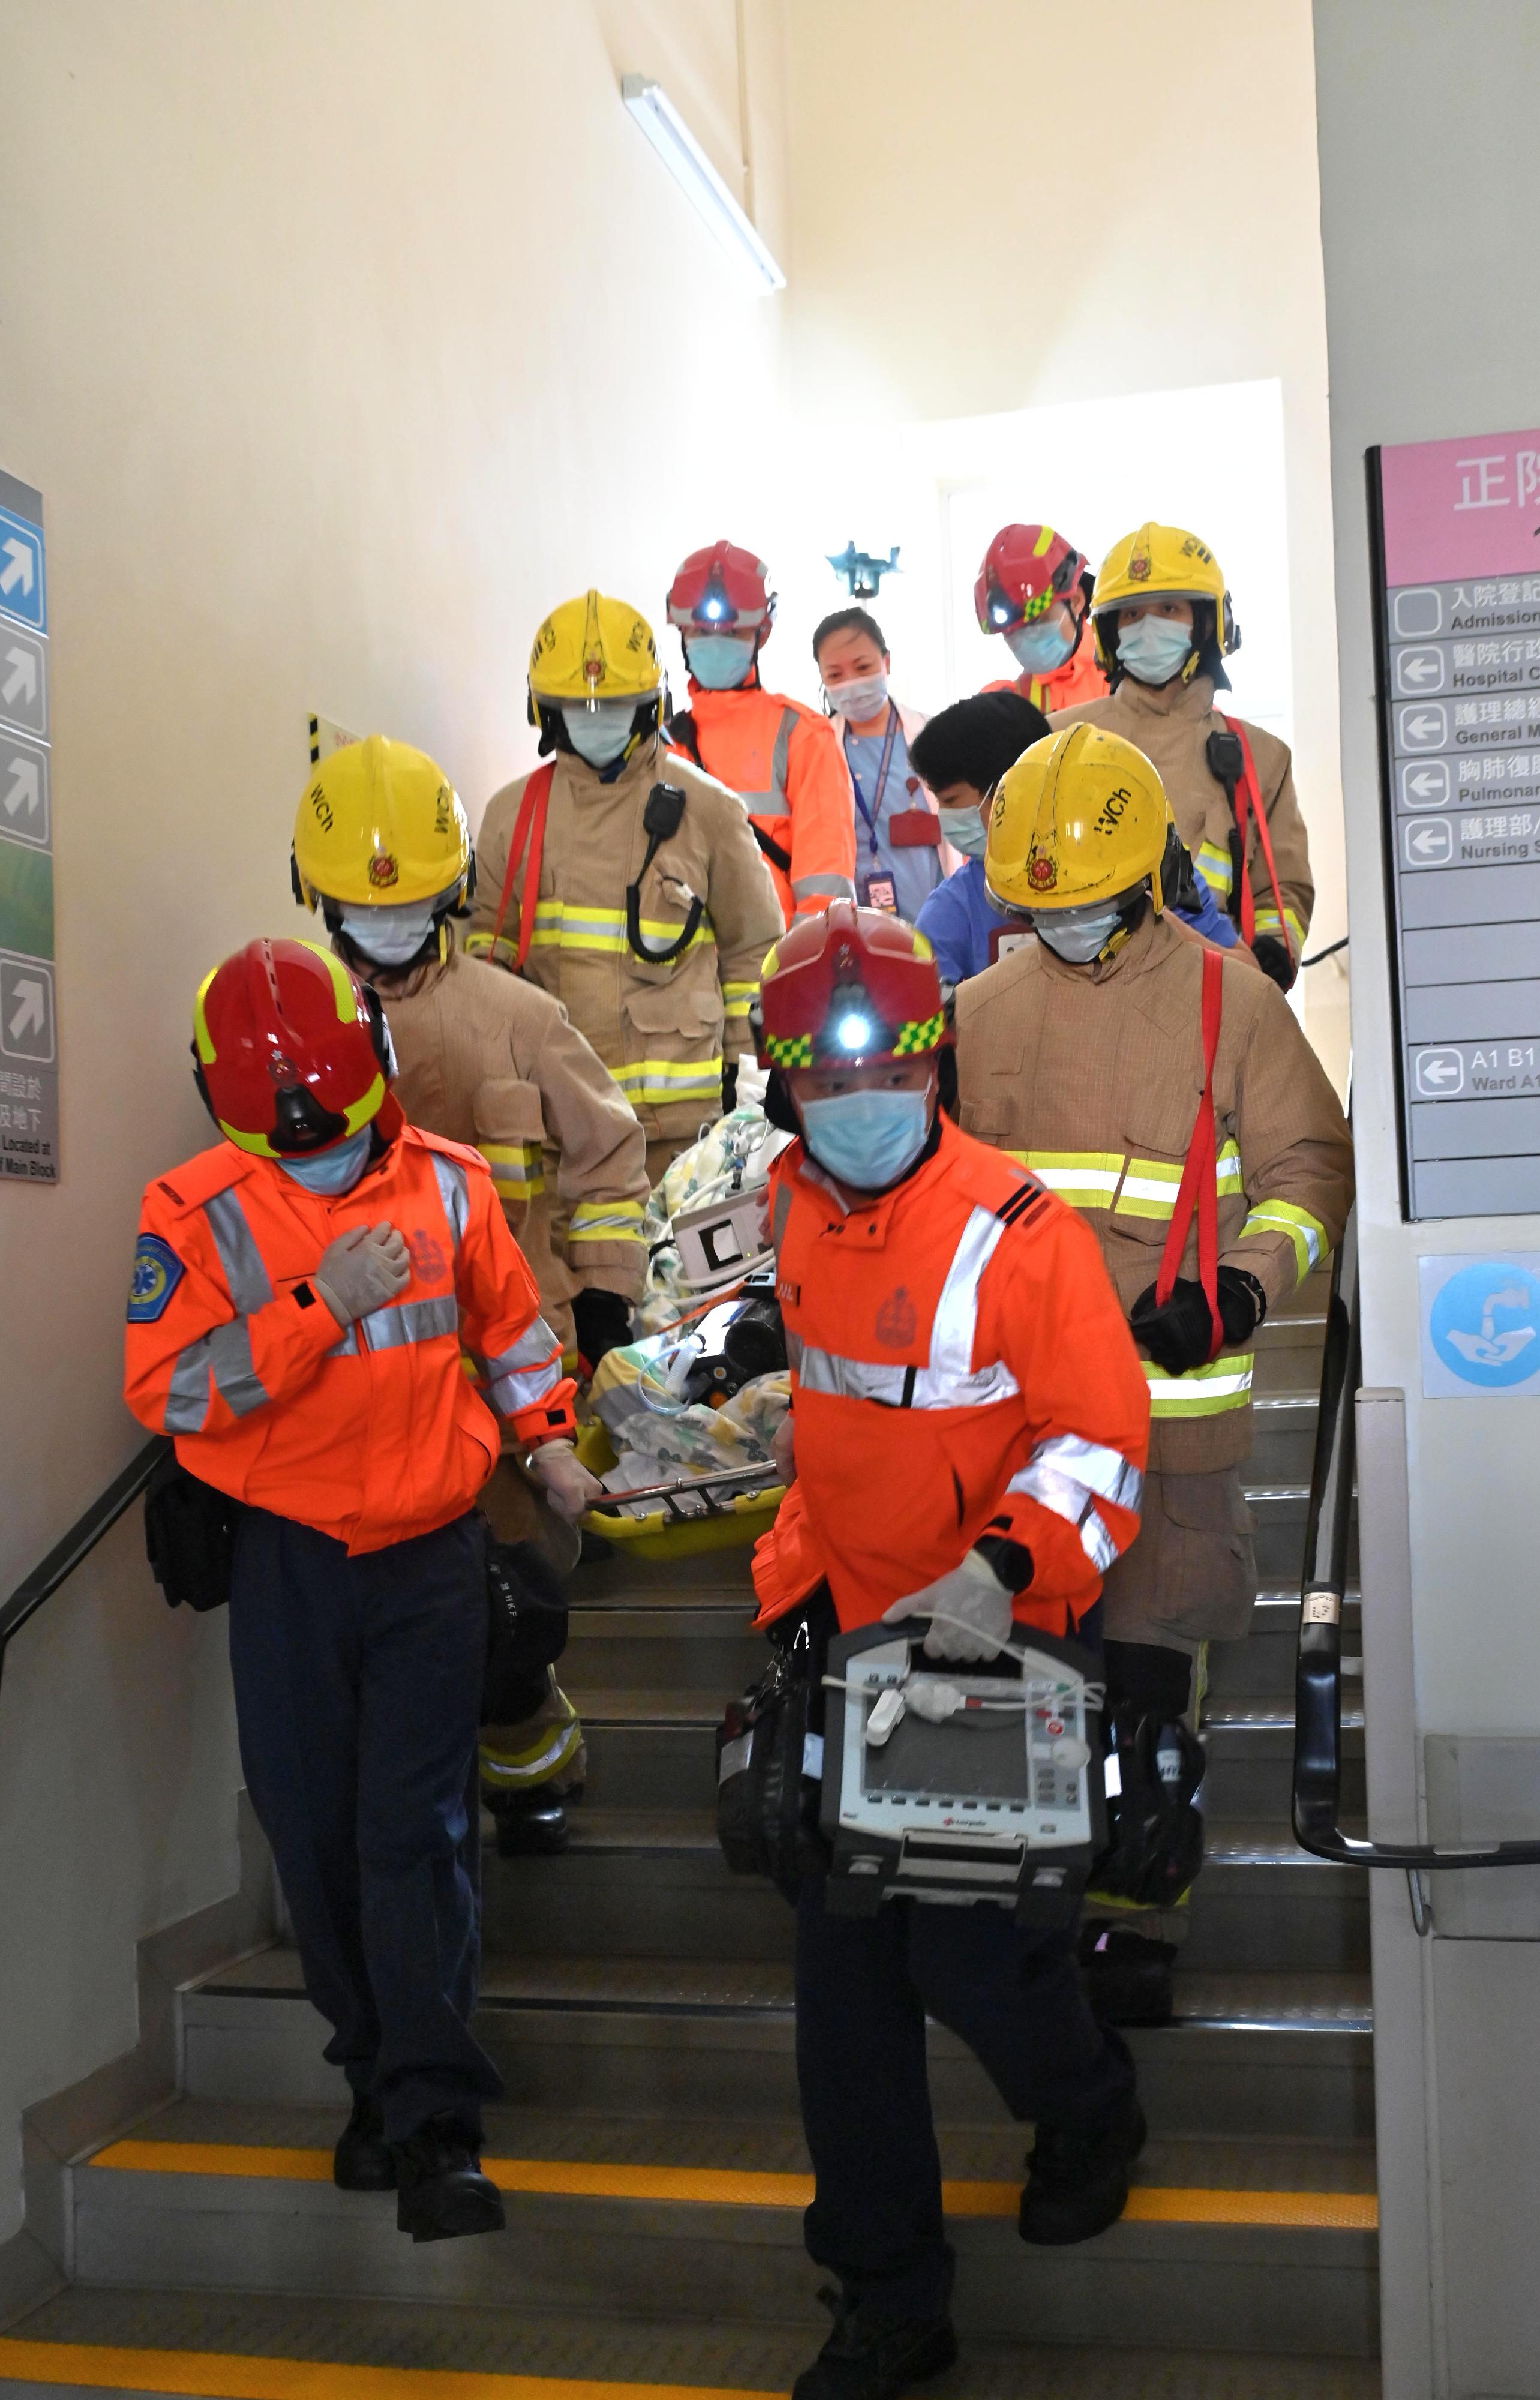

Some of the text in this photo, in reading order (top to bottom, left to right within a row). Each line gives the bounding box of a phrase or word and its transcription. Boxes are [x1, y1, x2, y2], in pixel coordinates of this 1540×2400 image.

[1453, 668, 1523, 687] Hospital
[1456, 725, 1521, 744] General
[1461, 842, 1528, 859] Nursing
[1471, 1047, 1534, 1069] A1 B1
[1472, 1076, 1516, 1091] Ward
[3, 1135, 40, 1154] Located
